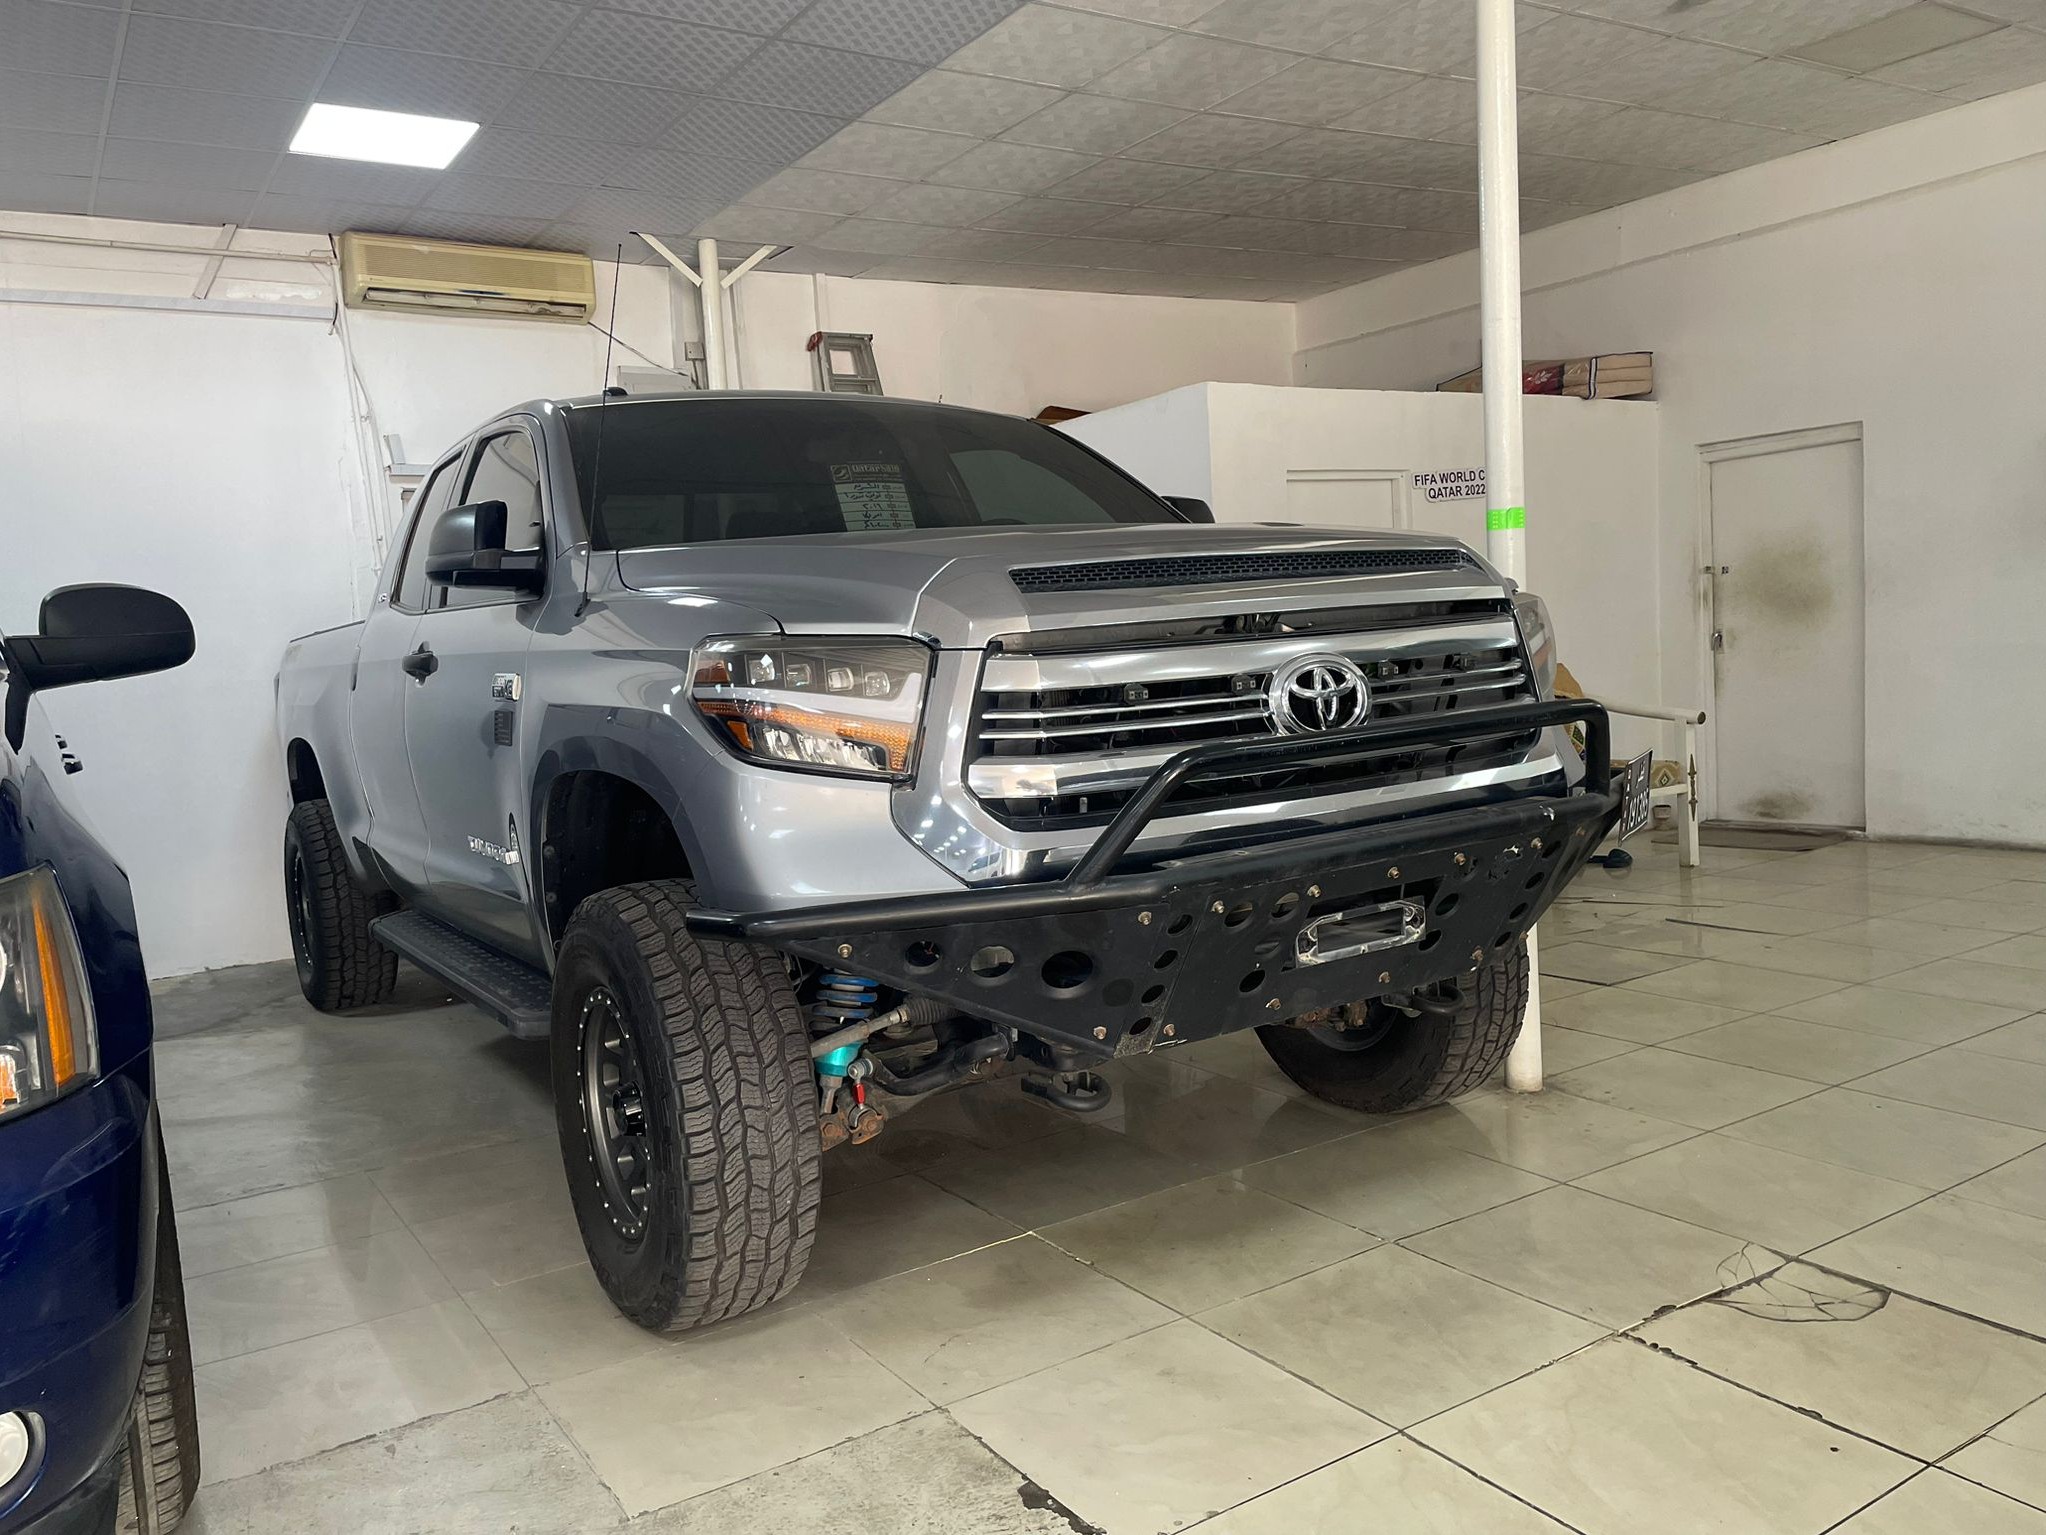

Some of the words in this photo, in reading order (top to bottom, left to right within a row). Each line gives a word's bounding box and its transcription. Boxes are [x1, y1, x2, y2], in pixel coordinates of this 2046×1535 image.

[1414, 474, 1437, 486] FIFA
[1440, 471, 1476, 484] WORLD
[1428, 486, 1463, 499] QATAR
[1465, 484, 1486, 496] 2022
